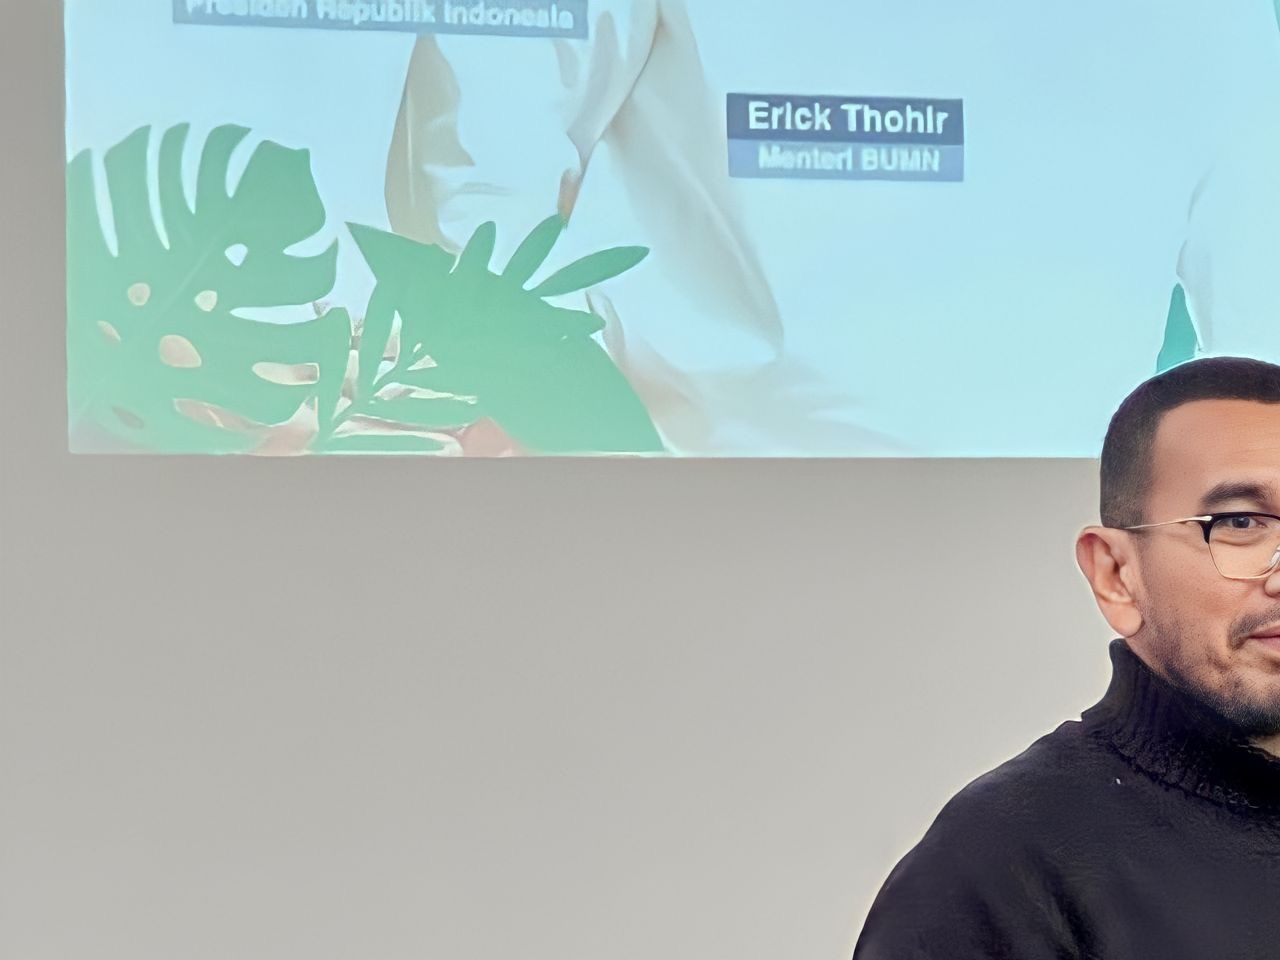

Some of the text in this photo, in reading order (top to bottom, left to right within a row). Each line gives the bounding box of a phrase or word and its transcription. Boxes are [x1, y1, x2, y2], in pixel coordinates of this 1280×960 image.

[444, 3, 574, 29] Indonesia
[748, 101, 949, 134] Erick Thohir
[861, 147, 940, 172] BUMN
